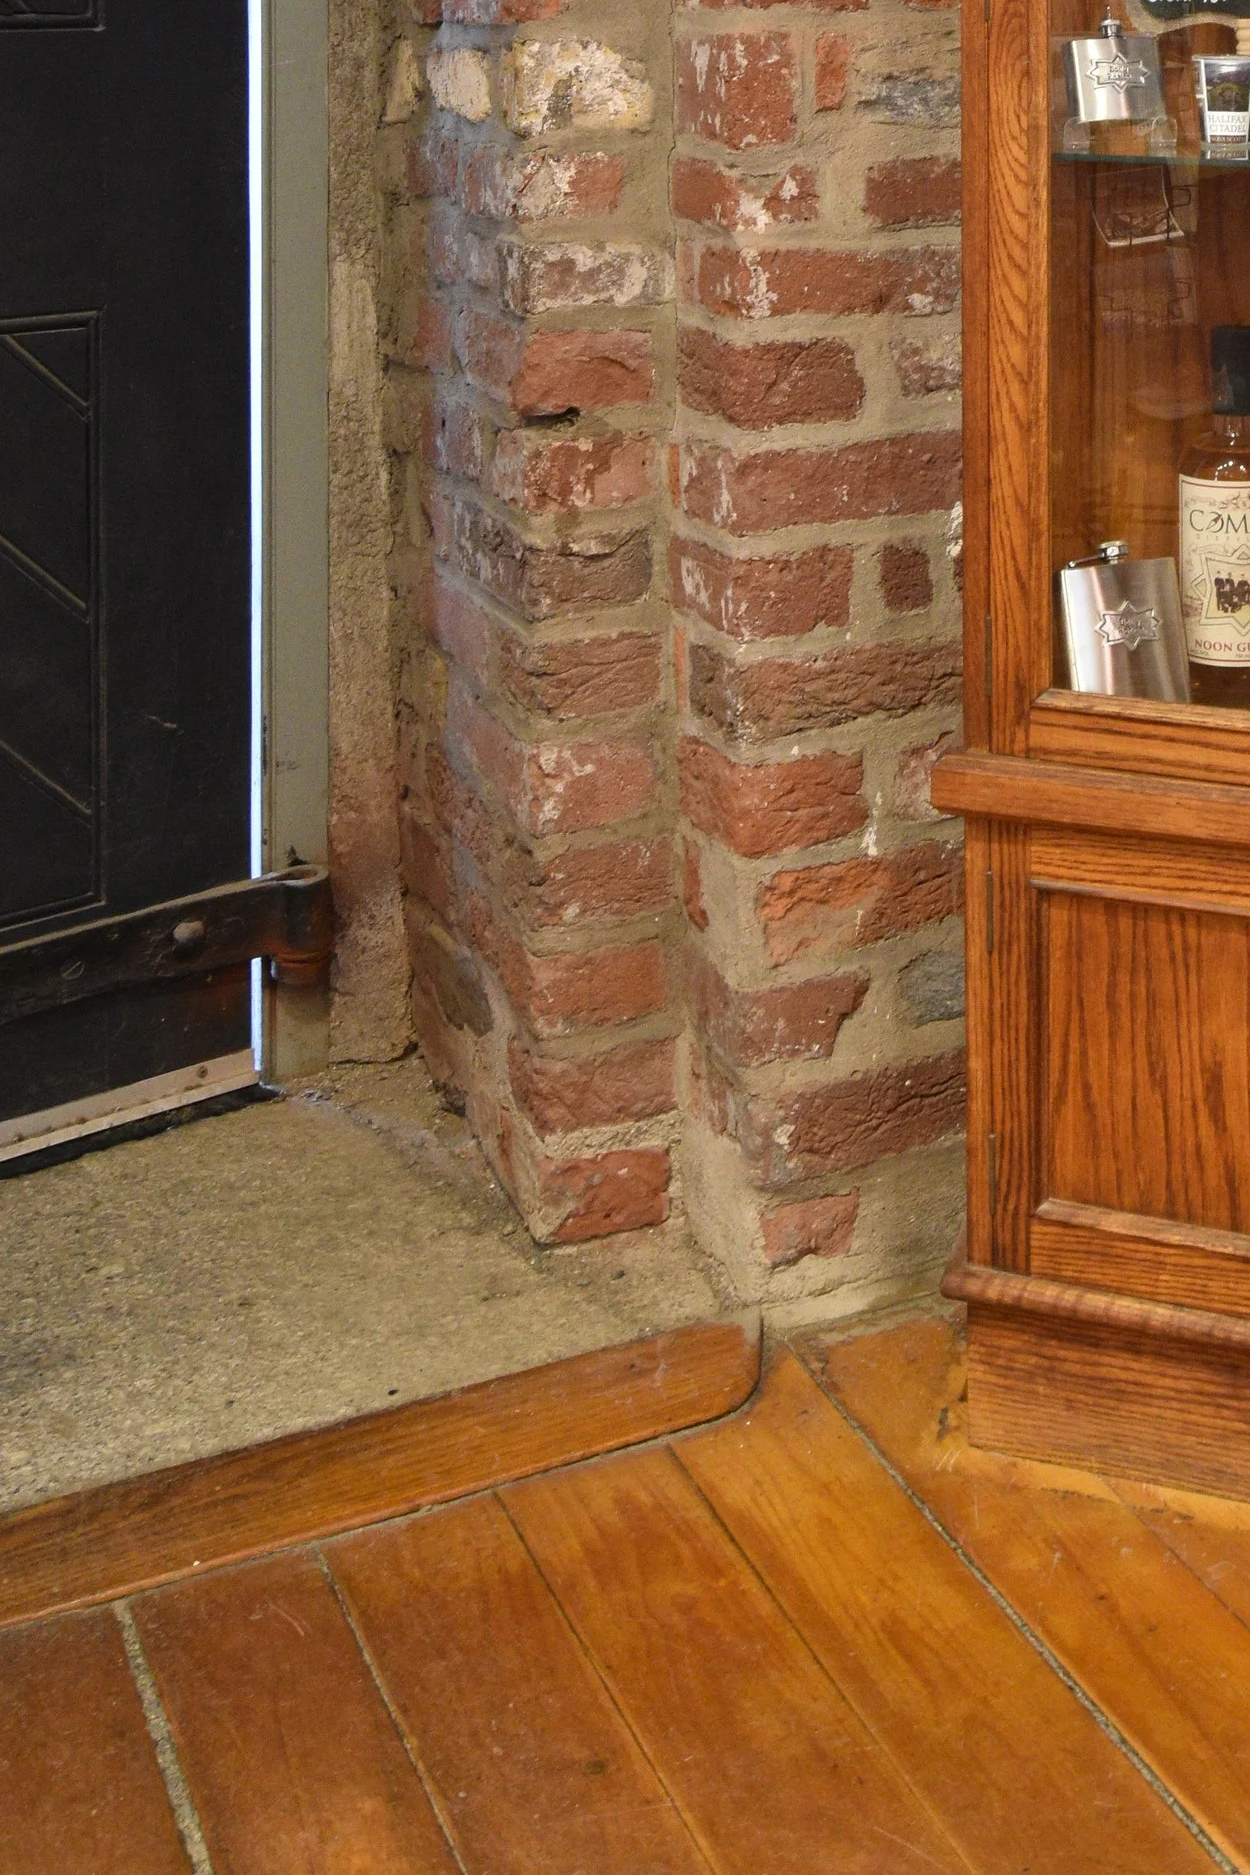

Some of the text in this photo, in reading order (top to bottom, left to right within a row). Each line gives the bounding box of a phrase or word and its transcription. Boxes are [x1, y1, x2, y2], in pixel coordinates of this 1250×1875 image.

[1208, 115, 1247, 123] HALIFAX
[1209, 124, 1246, 133] CITADEL
[1194, 638, 1233, 652] NOON
